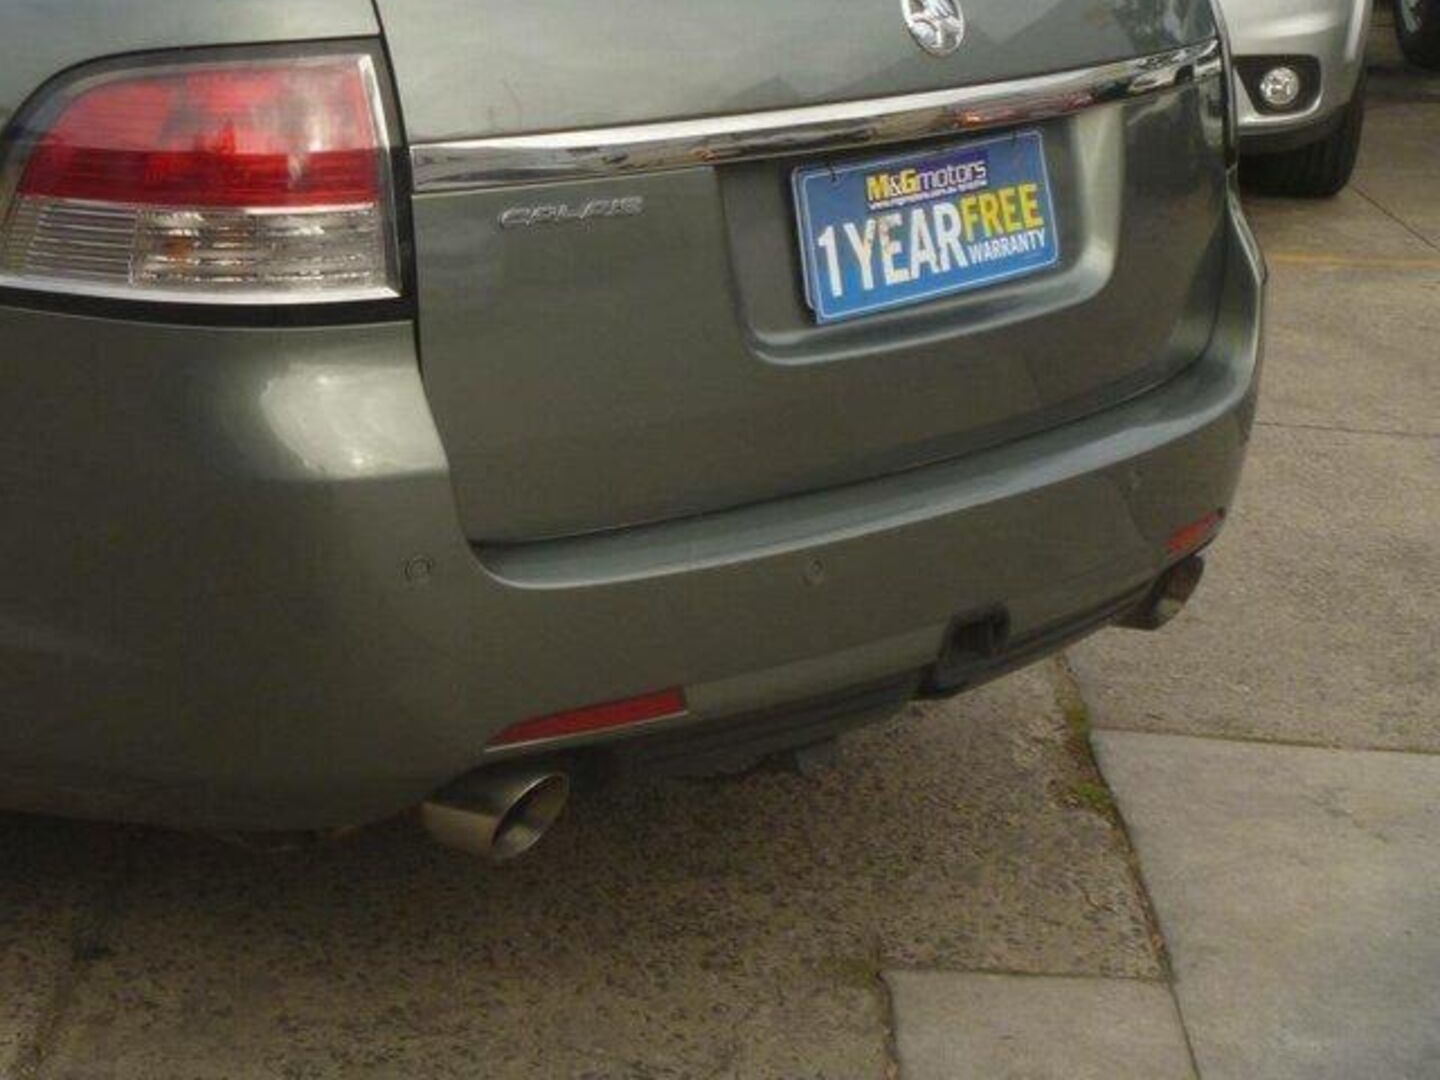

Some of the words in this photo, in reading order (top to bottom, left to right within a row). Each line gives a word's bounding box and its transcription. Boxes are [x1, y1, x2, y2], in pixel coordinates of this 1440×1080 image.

[818, 225, 842, 297] 1
[842, 202, 969, 290] YEAR
[960, 183, 1045, 242] FREE
[967, 228, 1046, 264] WARRANTY
